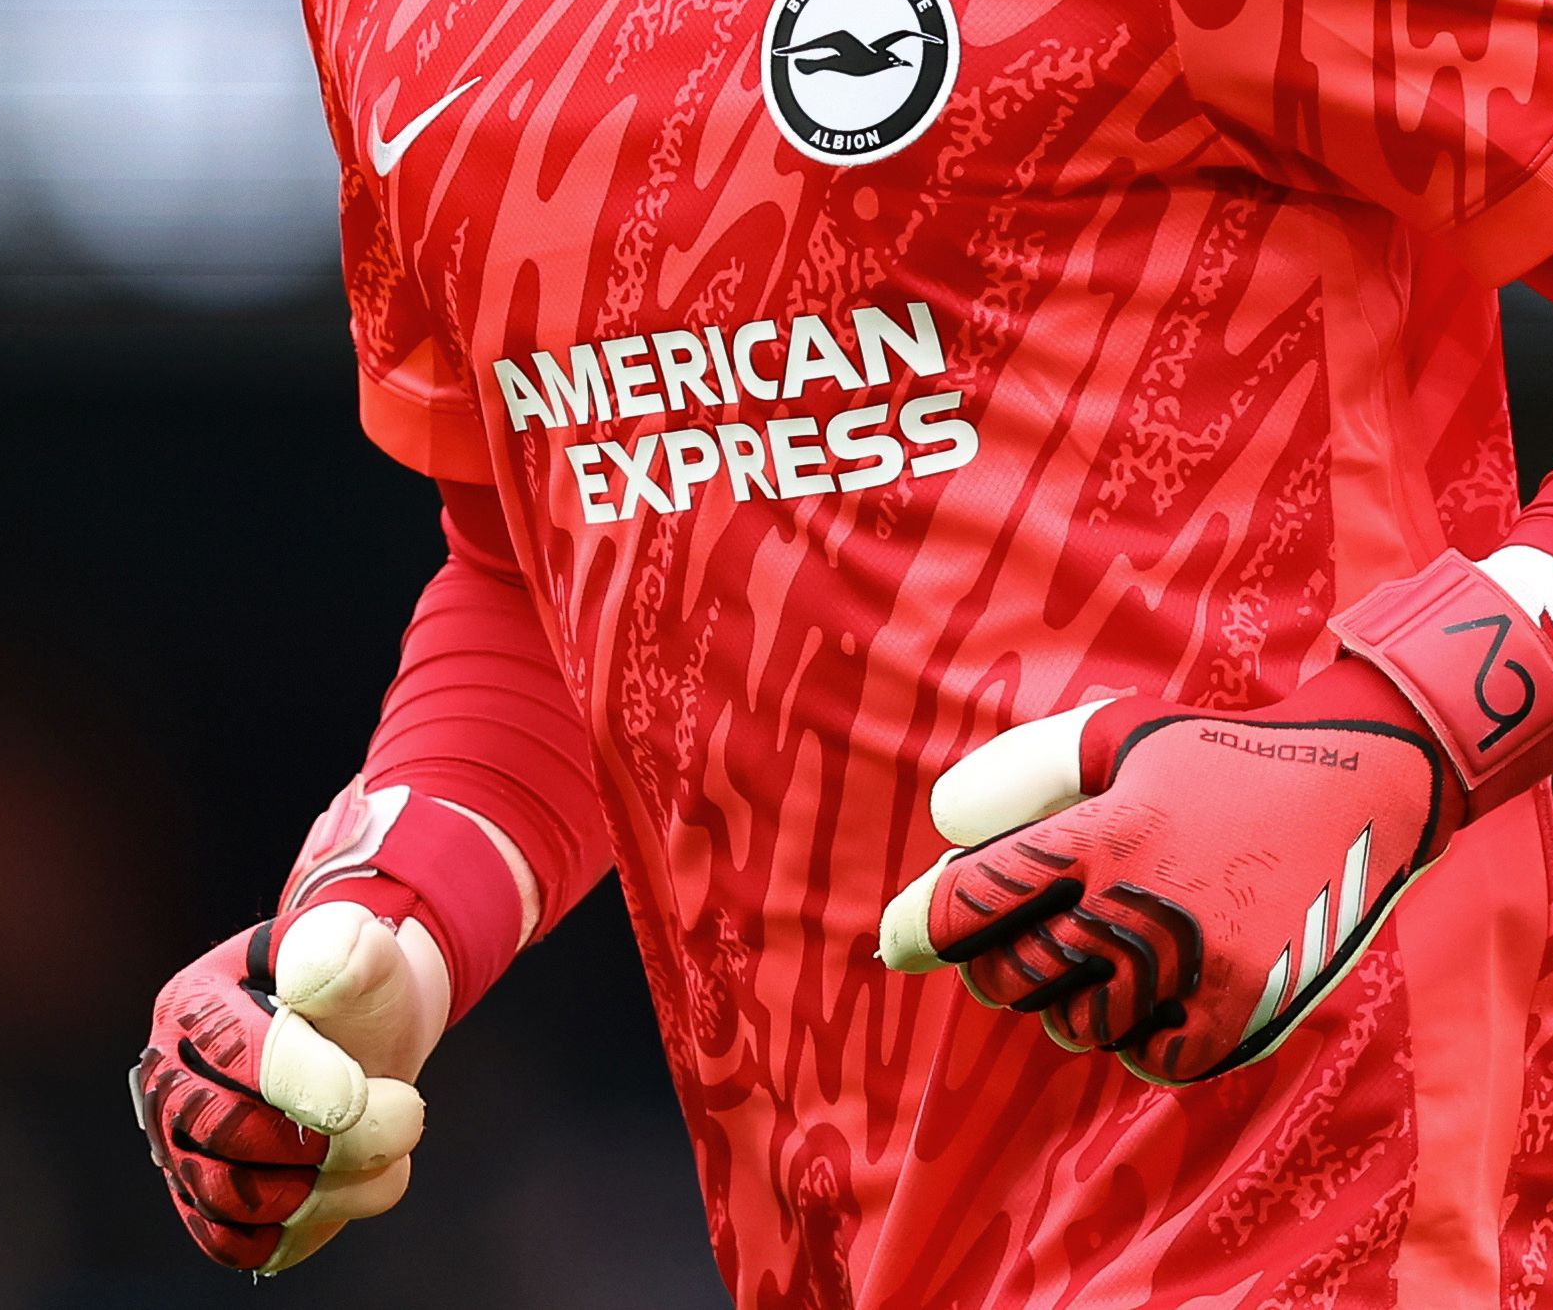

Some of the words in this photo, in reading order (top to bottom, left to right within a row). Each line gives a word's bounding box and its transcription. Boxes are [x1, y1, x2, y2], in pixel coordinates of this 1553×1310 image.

[809, 129, 881, 150] ALBION
[493, 302, 947, 432] AMERICAN
[565, 390, 979, 524] EXPRESS
[1200, 727, 1359, 771] PREDATOR
